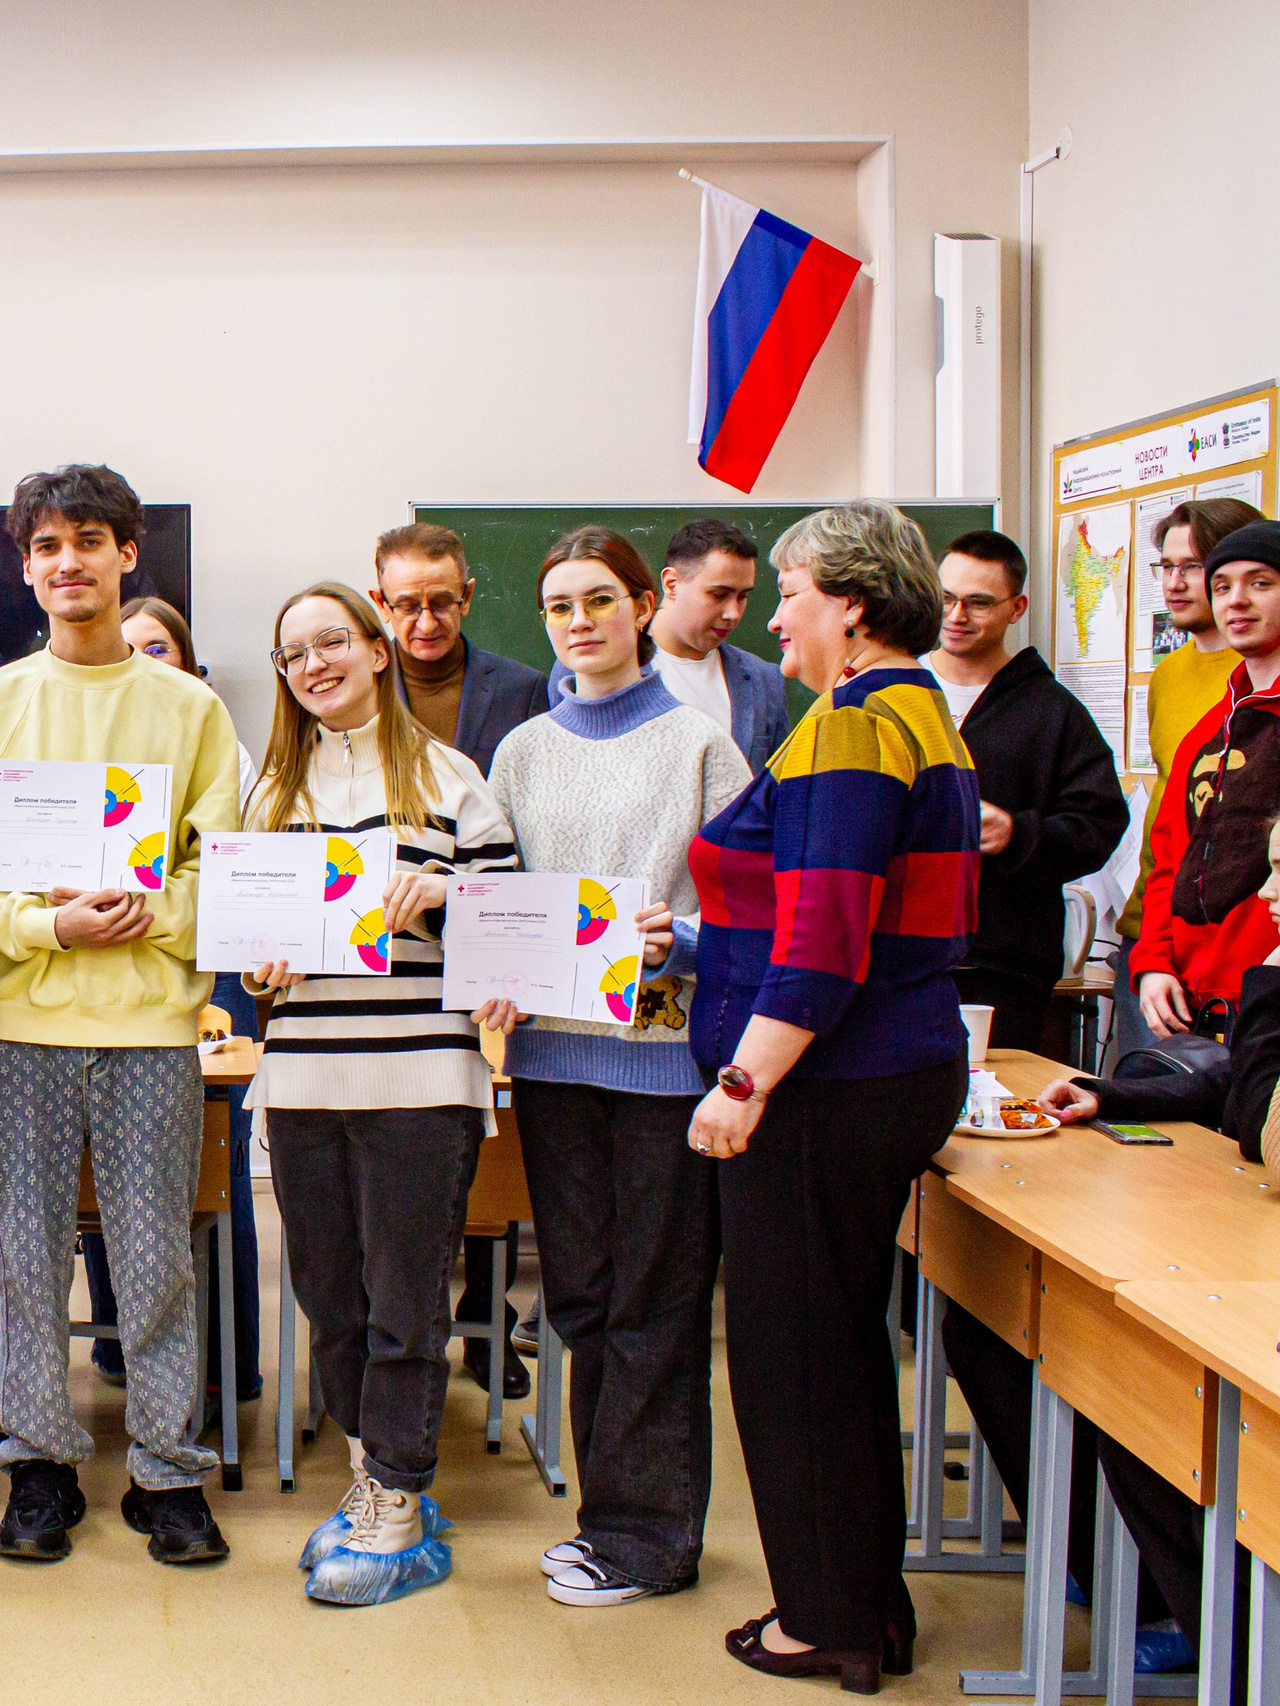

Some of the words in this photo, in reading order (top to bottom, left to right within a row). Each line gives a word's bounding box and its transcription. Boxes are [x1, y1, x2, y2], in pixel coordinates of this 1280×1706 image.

[975, 306, 985, 344] protego
[1201, 433, 1217, 450] ЕАСИ
[1134, 446, 1168, 464] НОВОСТИ
[1139, 464, 1164, 481] ЦЕНТРА
[478, 911, 506, 919] Диплом
